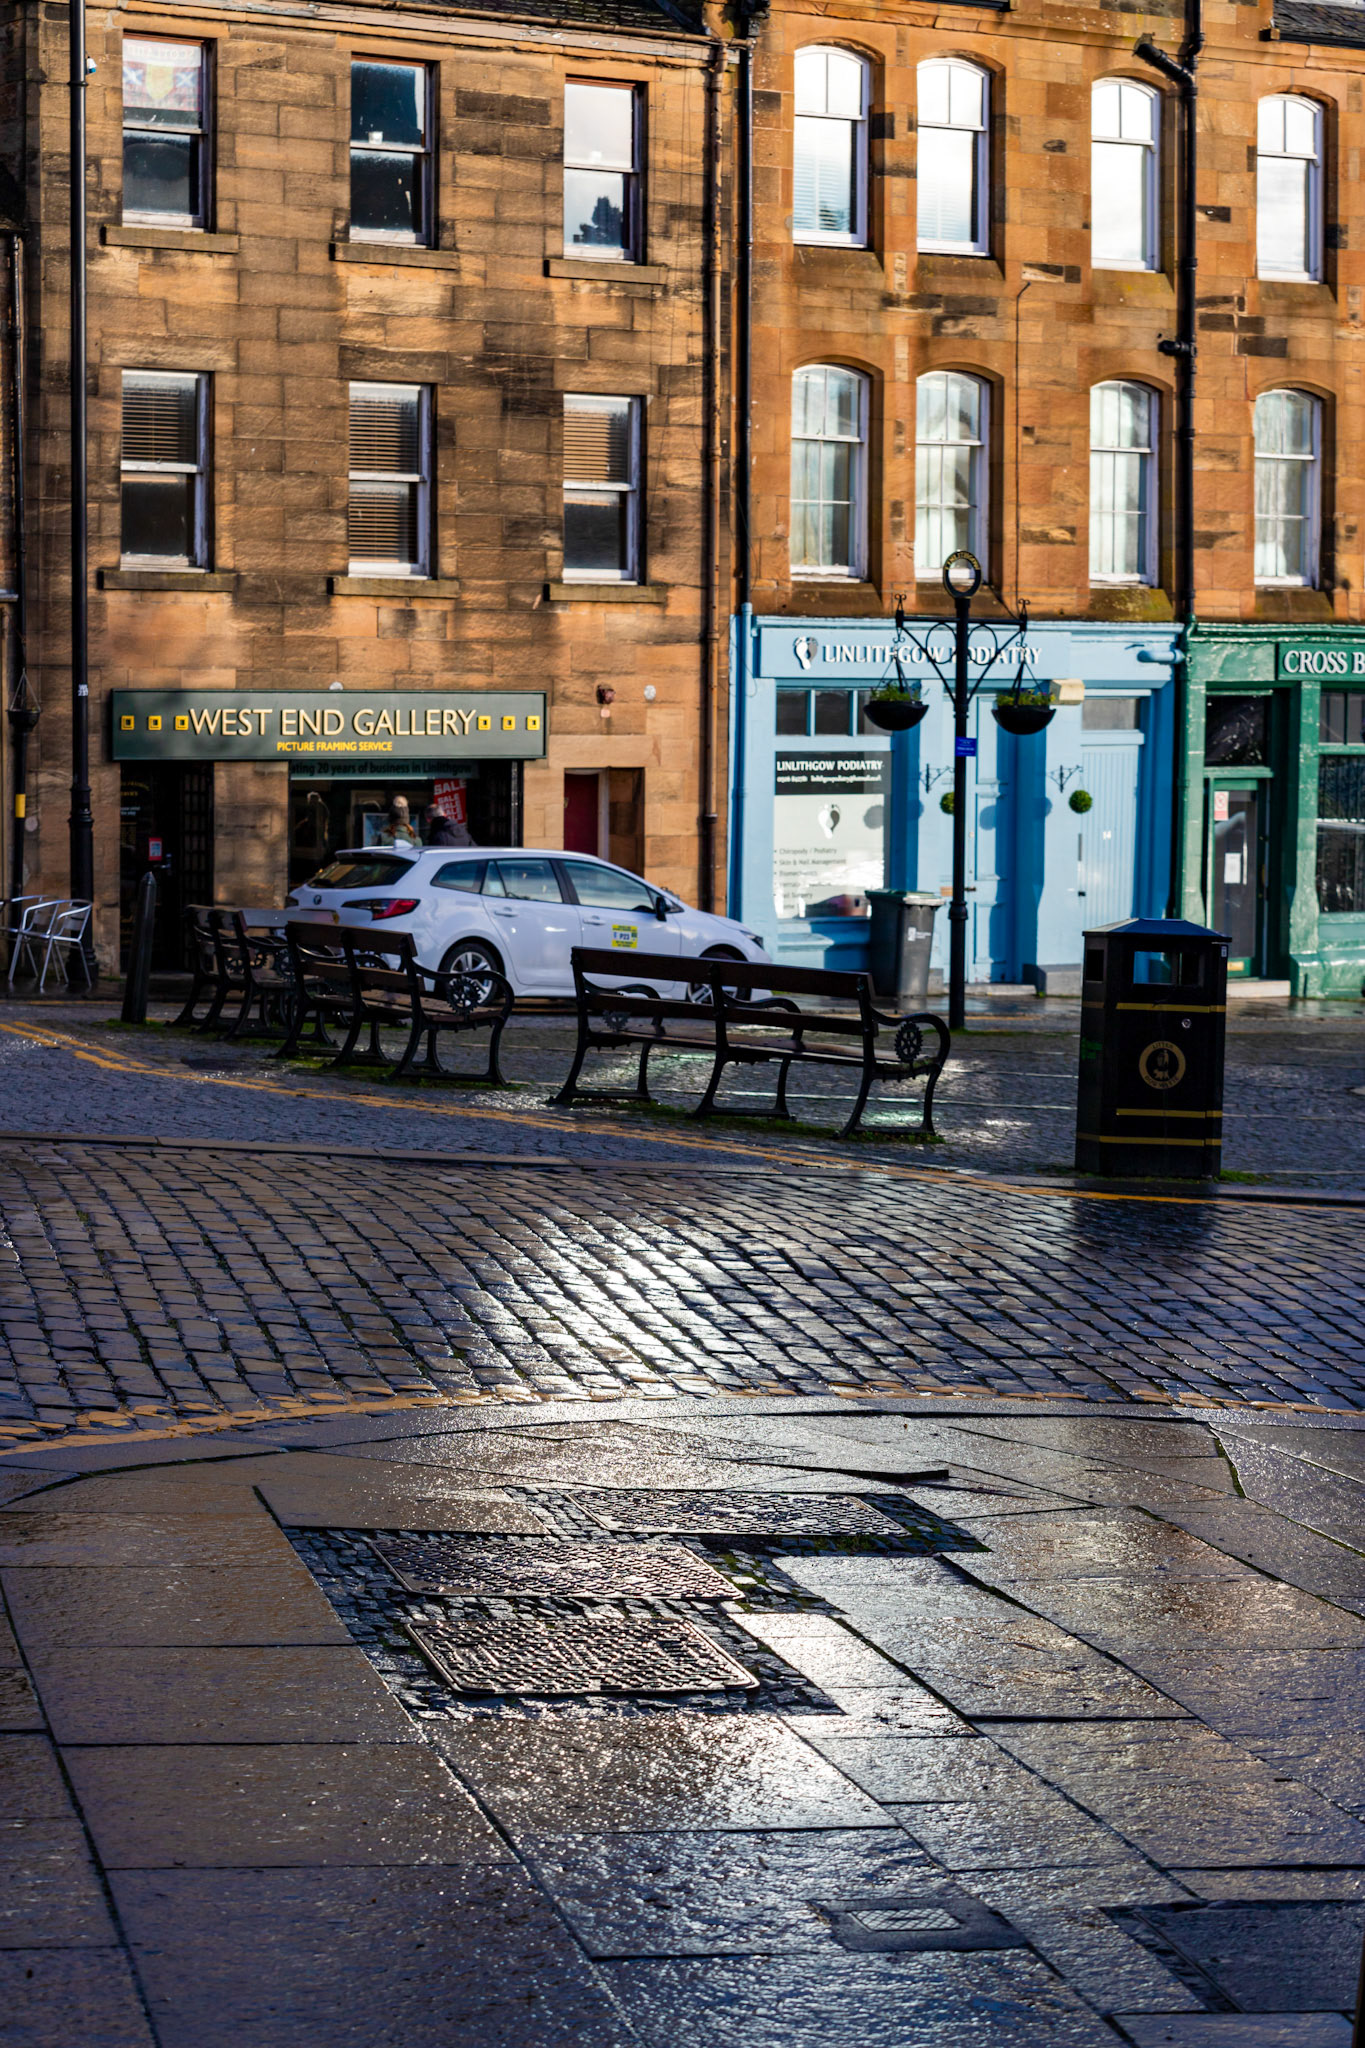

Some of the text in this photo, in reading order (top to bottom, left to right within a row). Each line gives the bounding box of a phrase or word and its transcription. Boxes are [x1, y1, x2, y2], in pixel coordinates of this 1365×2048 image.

[823, 644, 945, 665] LINLITHGOW
[1284, 650, 1348, 674] CROSS
[189, 708, 476, 736] WEST END GALLERY
[277, 741, 392, 752] PICTURE FRAMING SERVICE
[317, 762, 330, 774] 20
[331, 764, 357, 776] years
[358, 762, 369, 774] of
[370, 762, 410, 774] business
[412, 762, 422, 774] in
[423, 762, 472, 776] Linlithgow
[777, 760, 883, 771] LINLITHGOW PODIATRY
[434, 780, 467, 795] SALE
